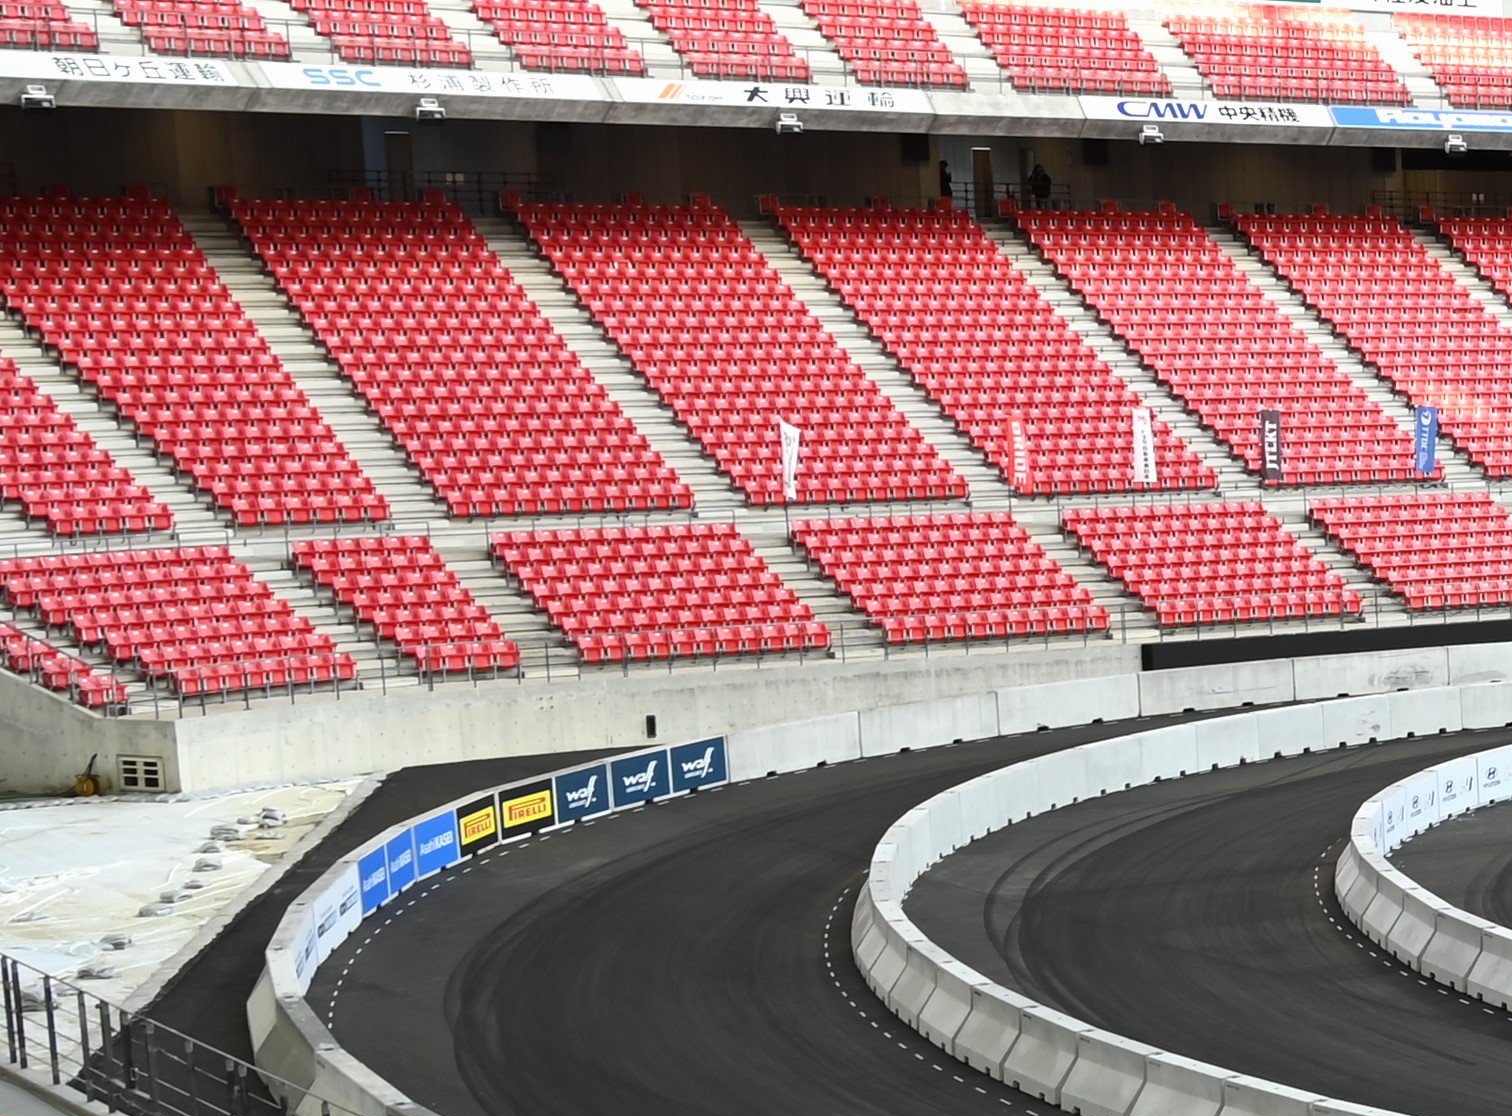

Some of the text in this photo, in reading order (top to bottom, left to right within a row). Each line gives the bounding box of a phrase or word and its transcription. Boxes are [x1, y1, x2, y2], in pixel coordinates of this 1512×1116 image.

[302, 68, 381, 87] SSC
[409, 73, 555, 95] 杉浦製作所
[744, 86, 895, 108] 大興運輸
[1116, 100, 1208, 121] CMW
[1218, 104, 1299, 123] 中央精機
[508, 797, 546, 821] PIRELLI
[464, 813, 492, 839] PIRELLI
